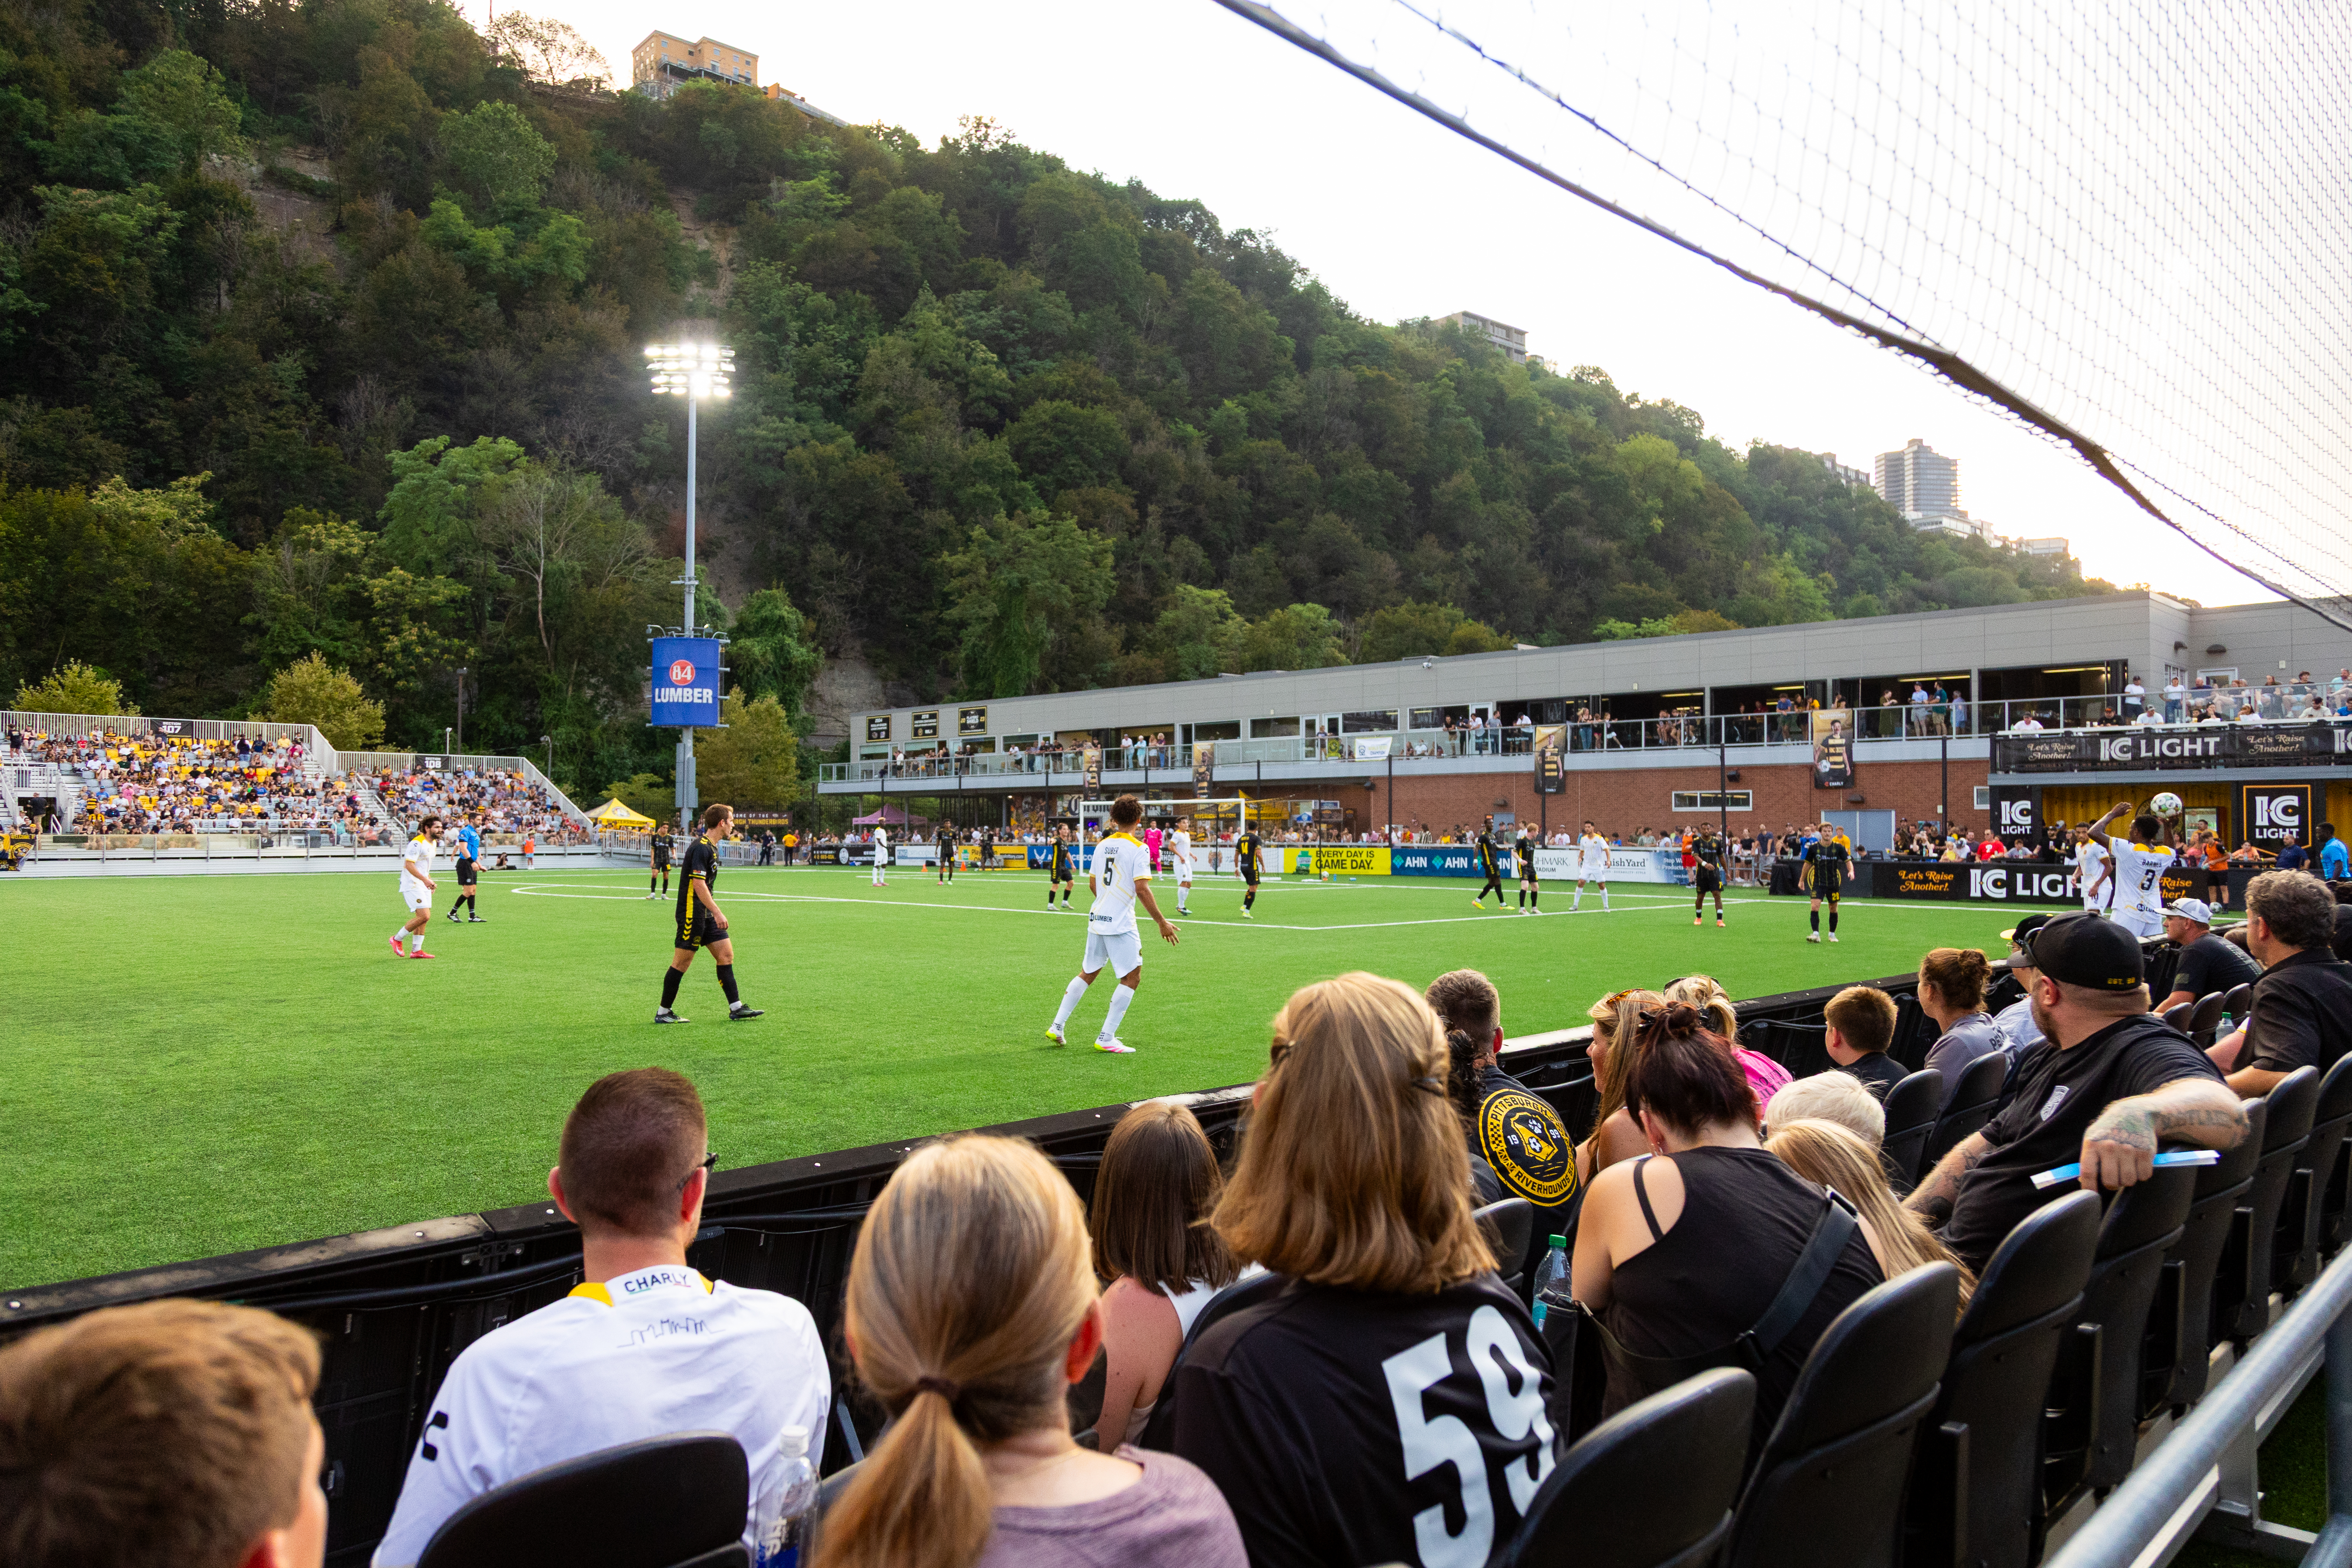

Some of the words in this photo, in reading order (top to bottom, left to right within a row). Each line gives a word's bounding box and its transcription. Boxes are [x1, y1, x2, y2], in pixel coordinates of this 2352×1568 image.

[672, 665, 692, 680] 84
[655, 687, 713, 704] LUMBER
[2247, 735, 2273, 743] Let's
[2275, 734, 2305, 745] Raise
[2051, 743, 2075, 752] Raise
[2100, 737, 2131, 761] IC
[2140, 737, 2220, 757] LIGHT
[2249, 744, 2300, 755] Another!
[2028, 752, 2072, 761] Another!
[2001, 800, 2031, 824] IC
[2255, 795, 2299, 826] IC
[2001, 825, 2031, 834] LIGHT
[2255, 828, 2299, 839] LIGHT
[1315, 859, 1347, 869] GAME
[1351, 860, 1373, 870] DAY.
[1405, 857, 1427, 868] AHN
[1444, 857, 1468, 868] AHN
[1497, 858, 1510, 869] HN
[1103, 857, 1115, 886] 5
[1898, 870, 1923, 880] Let's
[1925, 871, 1954, 883] Raise
[1900, 881, 1949, 892] Another!
[1970, 869, 2007, 898] IC
[2016, 873, 2084, 898] LIGH
[2140, 869, 2156, 891] 3
[2159, 877, 2192, 889] Raise
[1490, 1096, 1547, 1122] PITTSBURGH
[1507, 1134, 1519, 1145] 19
[1550, 1129, 1561, 1139] 99
[1514, 1171, 1571, 1195] RIVERHOUNDS
[624, 1273, 687, 1292] CHARLY
[1381, 1304, 1556, 1568] 59
